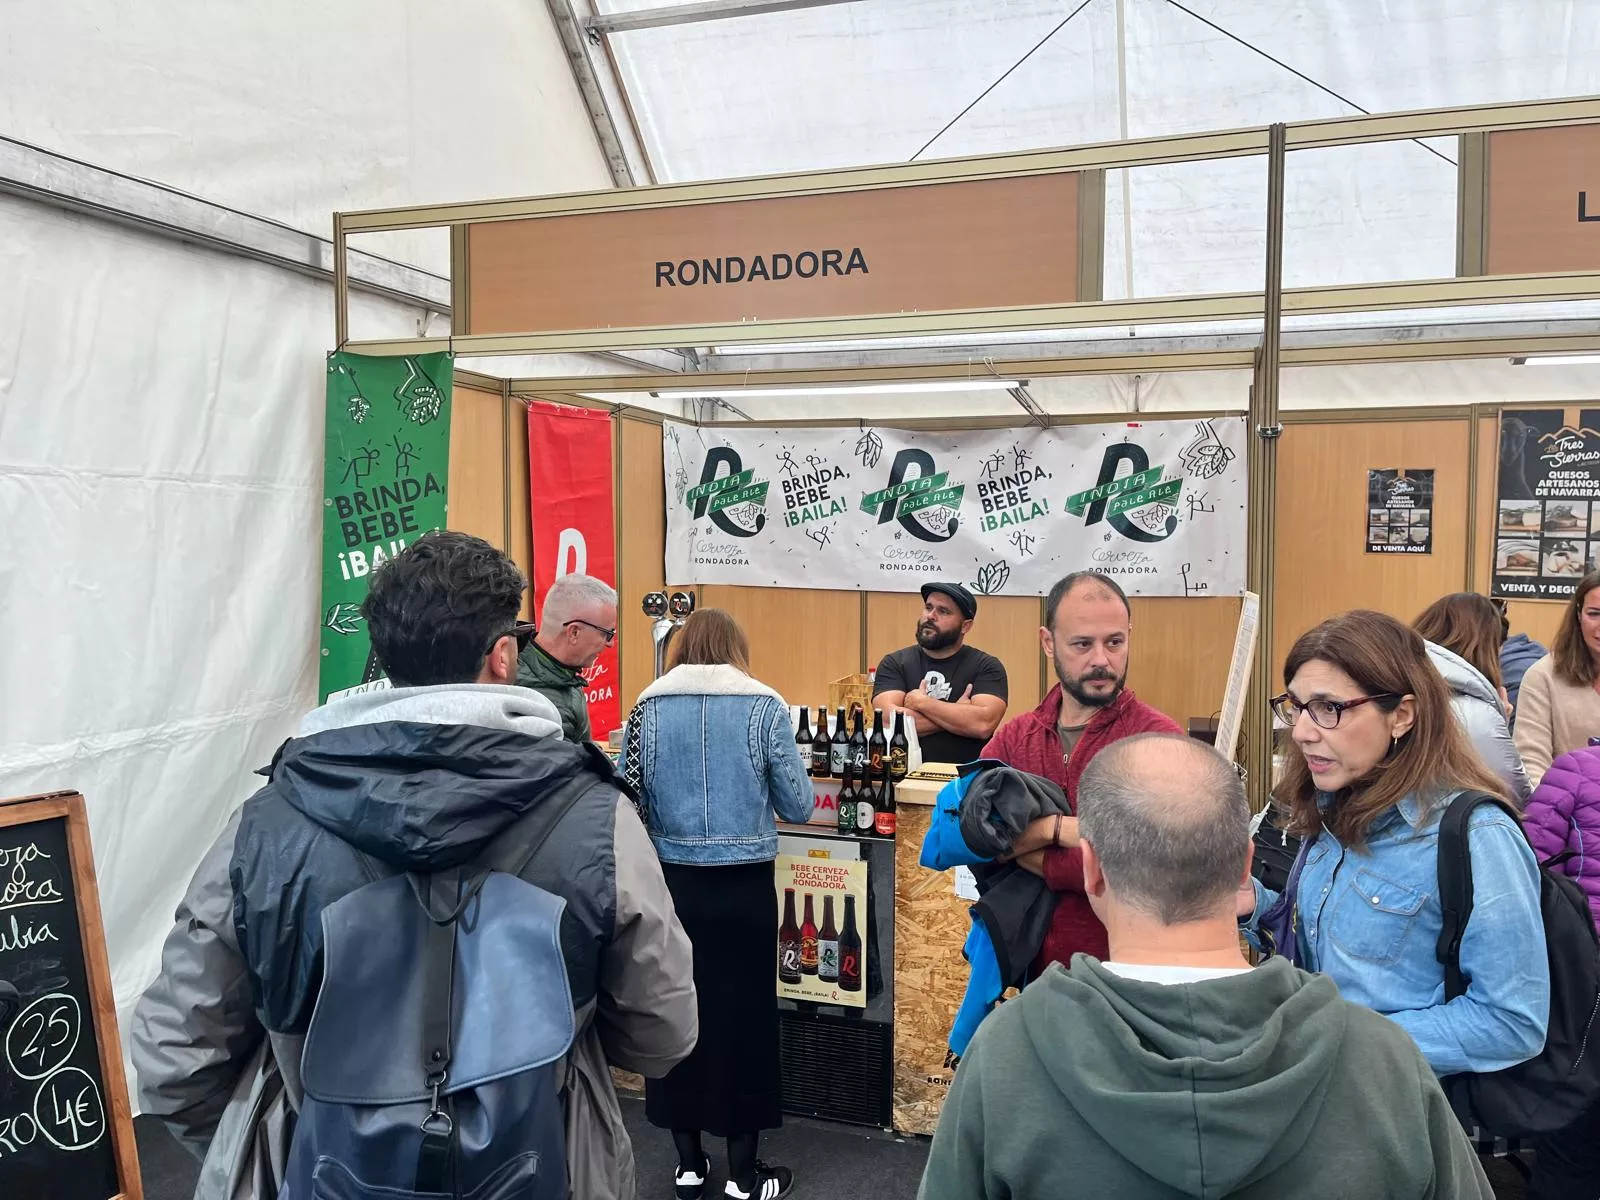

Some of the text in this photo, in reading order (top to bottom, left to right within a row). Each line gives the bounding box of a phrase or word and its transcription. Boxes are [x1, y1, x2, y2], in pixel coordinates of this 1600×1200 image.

[655, 247, 869, 287] RONDADORA
[1555, 436, 1584, 451] Tres
[1540, 451, 1600, 468] Sierras
[692, 475, 740, 498] INDIA
[782, 466, 850, 493] BRINDA,
[977, 465, 1053, 498] BRINDA,
[1537, 479, 1600, 488] ARTESANOS
[1548, 471, 1590, 480] QUESOS
[335, 473, 446, 519] BRINDA,
[785, 484, 831, 510] BEBE
[874, 478, 932, 502] INDIA
[1080, 473, 1146, 503] INDIA
[1535, 488, 1600, 497] DE NAVARRA
[981, 486, 1032, 514] BEBE
[783, 496, 848, 528] ¡BAILA!
[979, 497, 1050, 533] ¡BAILA!
[341, 506, 418, 547] BEBE
[1406, 544, 1426, 552] AQUÍ
[694, 558, 750, 566] RONDADORA
[879, 563, 943, 572] RONDADORA
[1500, 583, 1536, 593] VENTA
[1539, 584, 1547, 593] Y
[790, 864, 849, 876] BEBE CERVEZA
[825, 875, 844, 883] PIDE
[792, 878, 847, 890] RONDADORA
[52, 1083, 97, 1143] 4€
